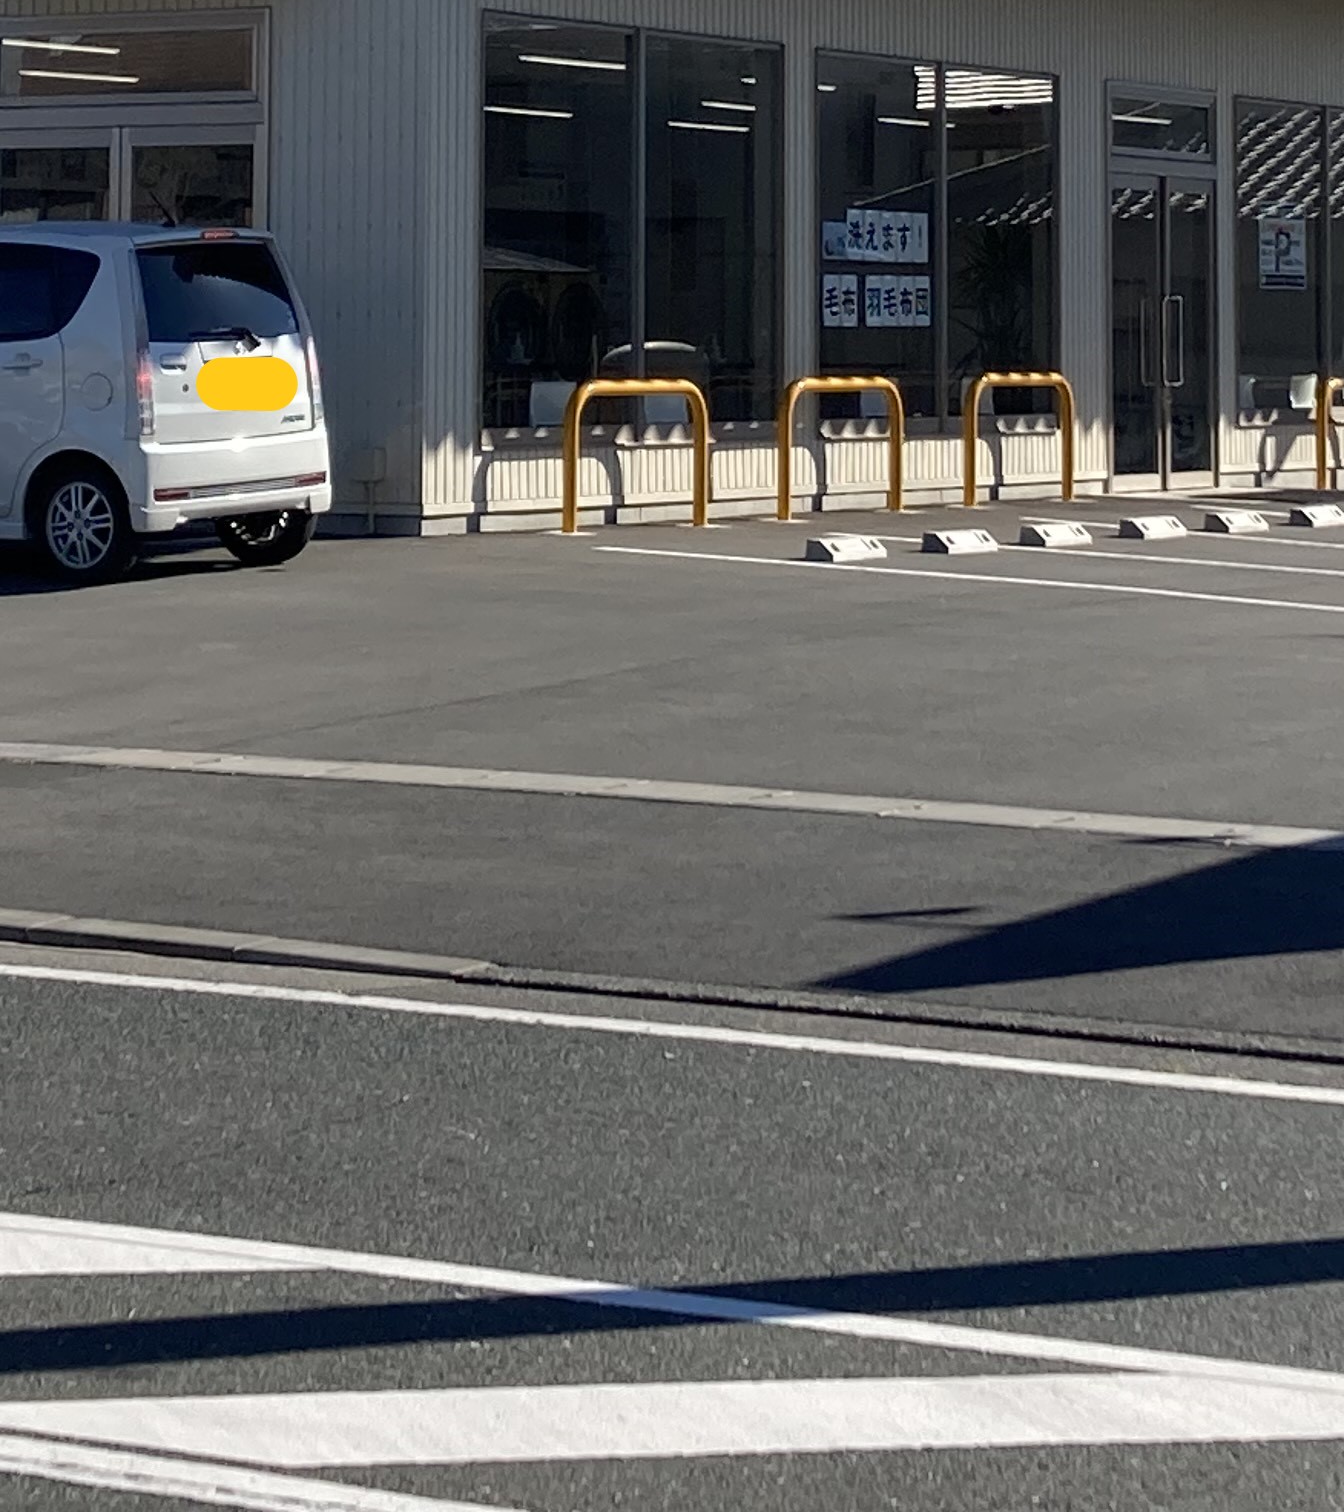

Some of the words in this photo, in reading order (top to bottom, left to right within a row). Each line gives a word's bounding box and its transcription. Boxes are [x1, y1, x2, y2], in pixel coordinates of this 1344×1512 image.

[824, 286, 856, 317] 毛布
[866, 286, 929, 317] 羽毛布団
